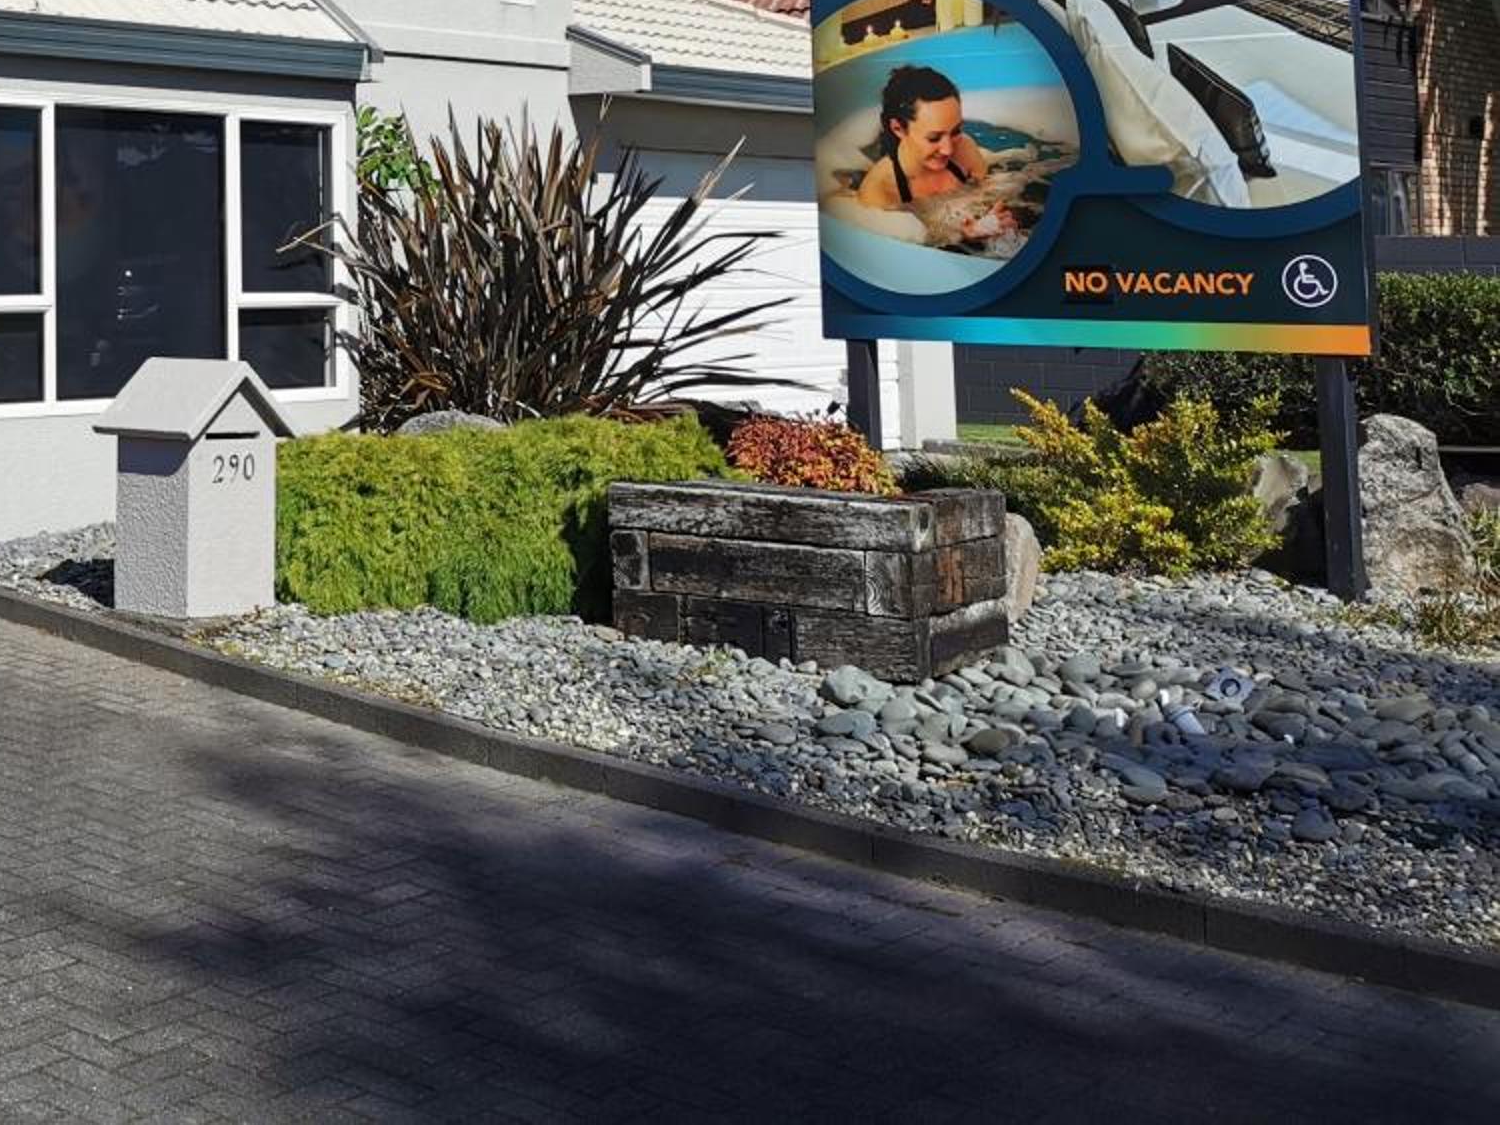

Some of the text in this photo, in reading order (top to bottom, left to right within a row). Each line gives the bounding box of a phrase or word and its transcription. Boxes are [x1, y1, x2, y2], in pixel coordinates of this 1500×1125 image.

[1064, 271, 1255, 296] NO VACANCY
[211, 453, 255, 484] 290
